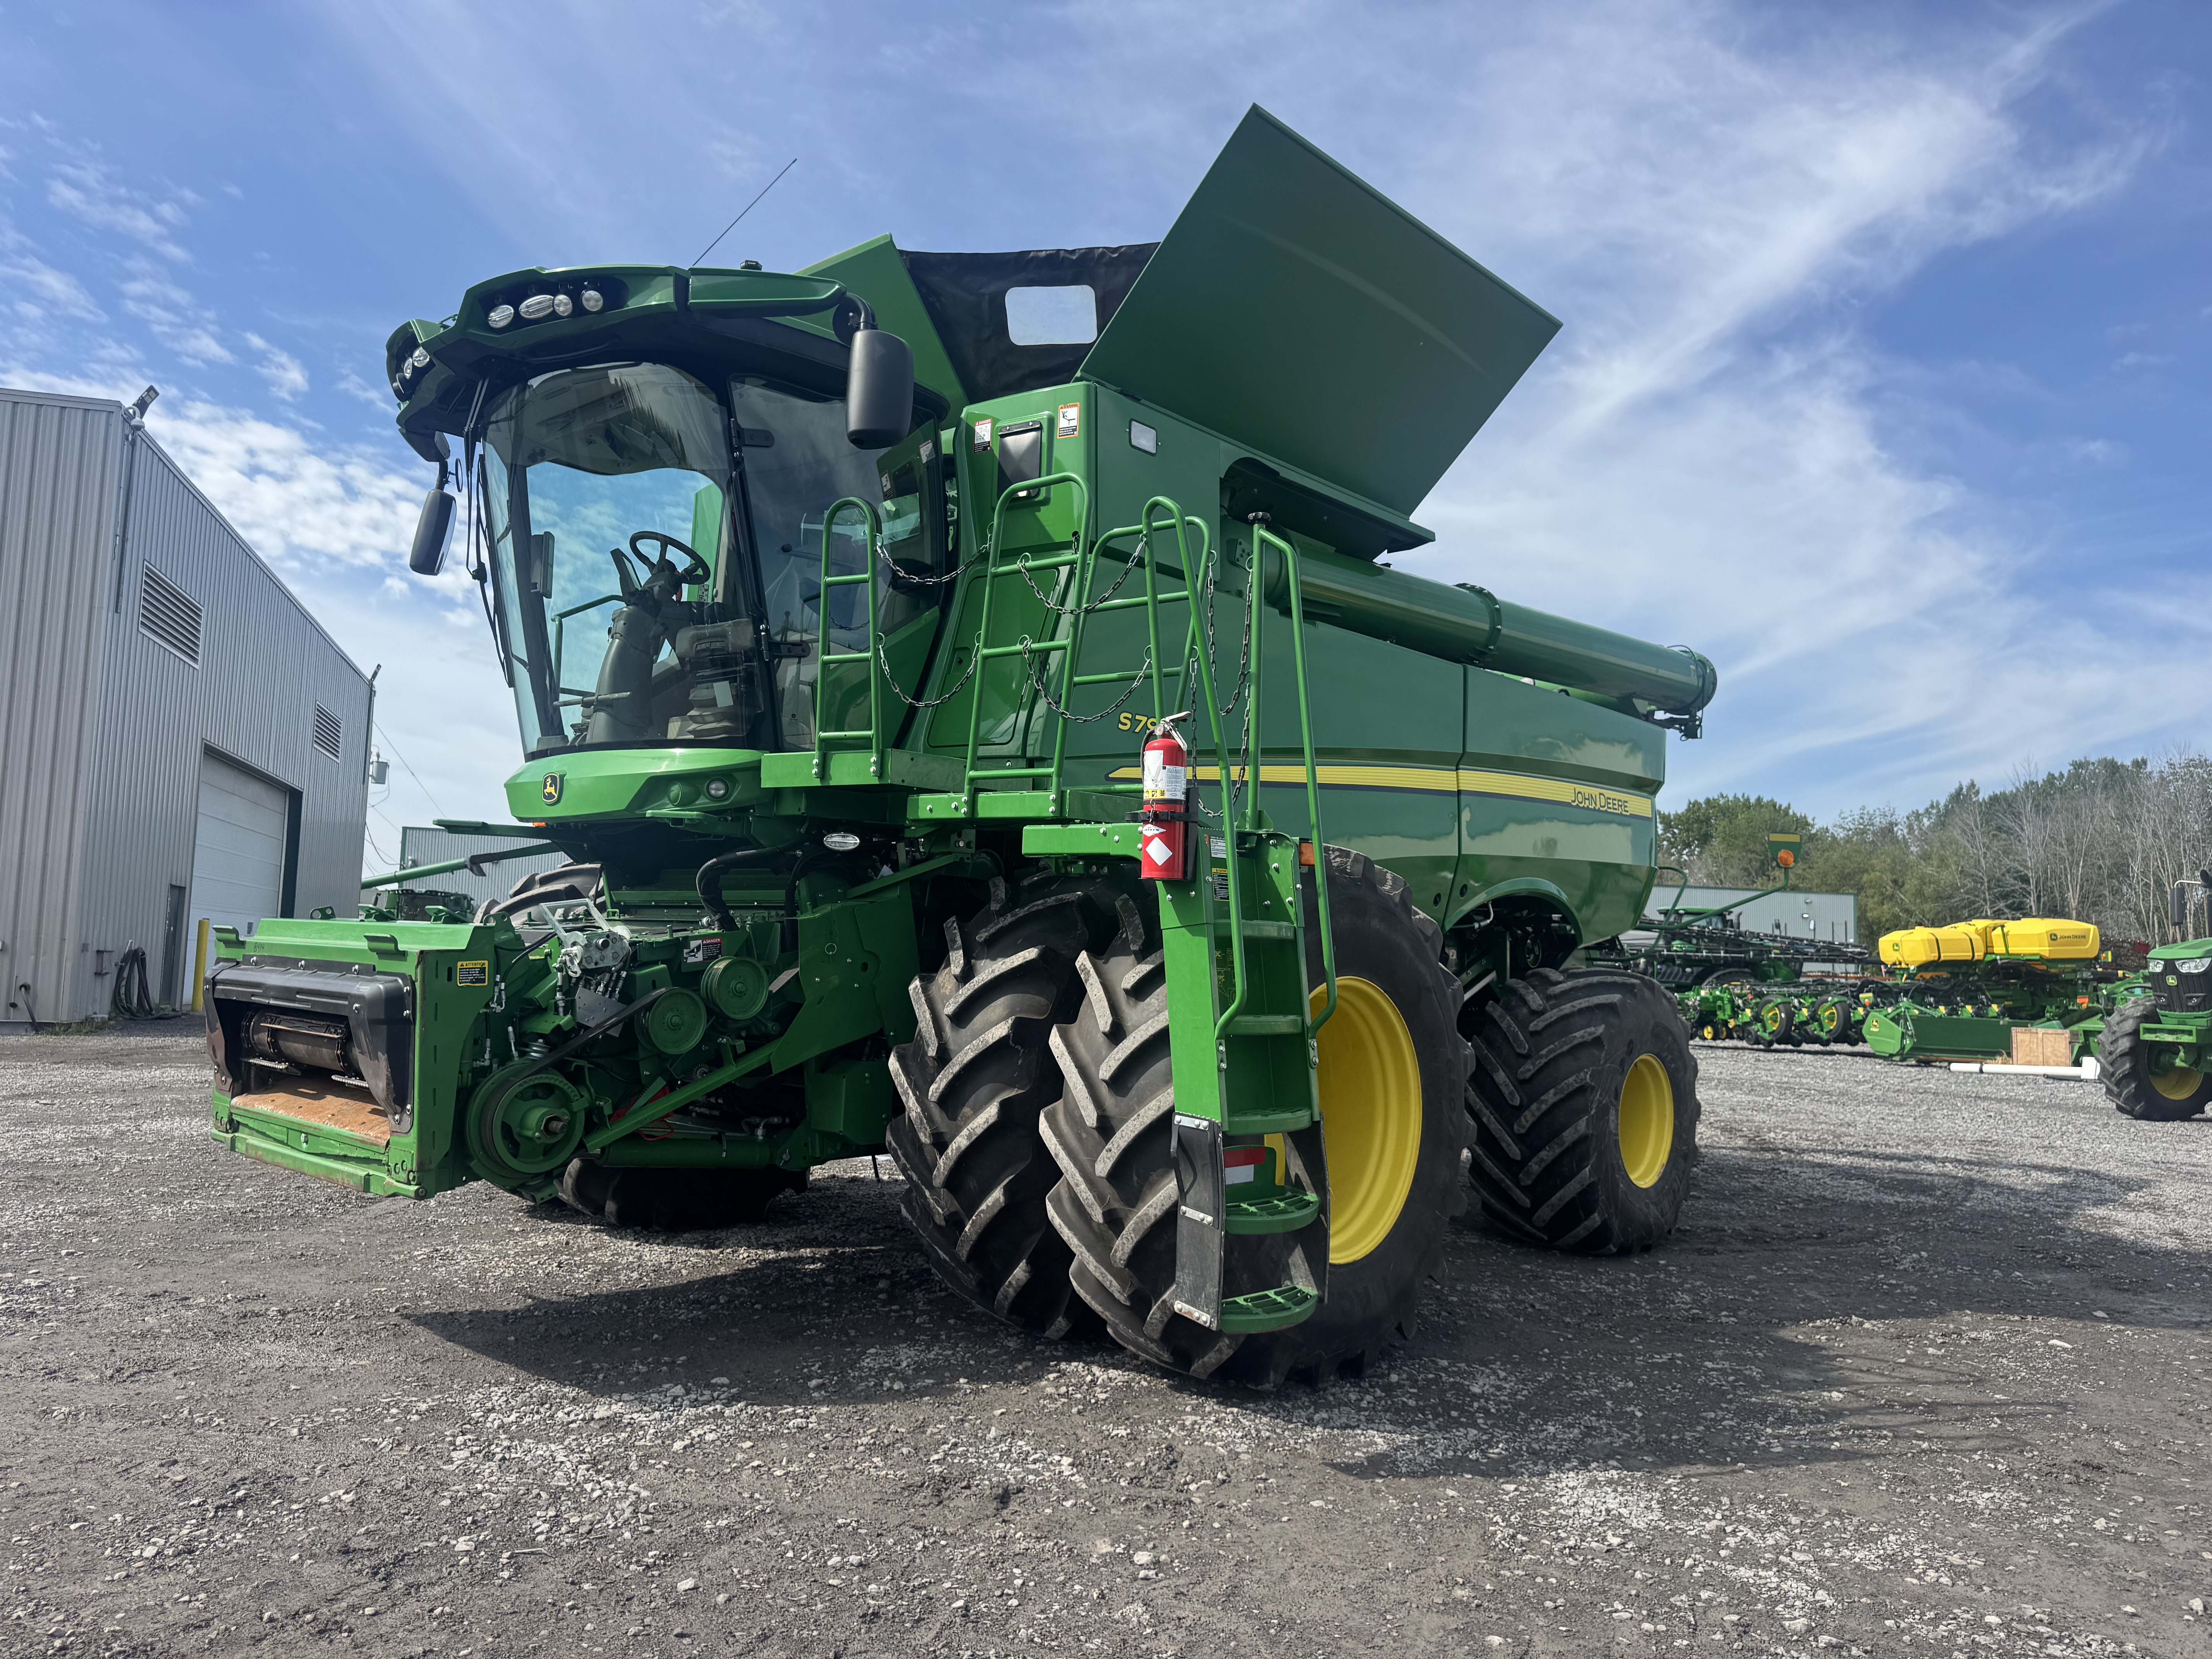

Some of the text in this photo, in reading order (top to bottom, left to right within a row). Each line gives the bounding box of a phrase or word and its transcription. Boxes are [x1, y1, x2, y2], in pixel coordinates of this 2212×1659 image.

[1118, 712, 1157, 732] S79
[1571, 787, 1629, 813] JOHN DEERE
